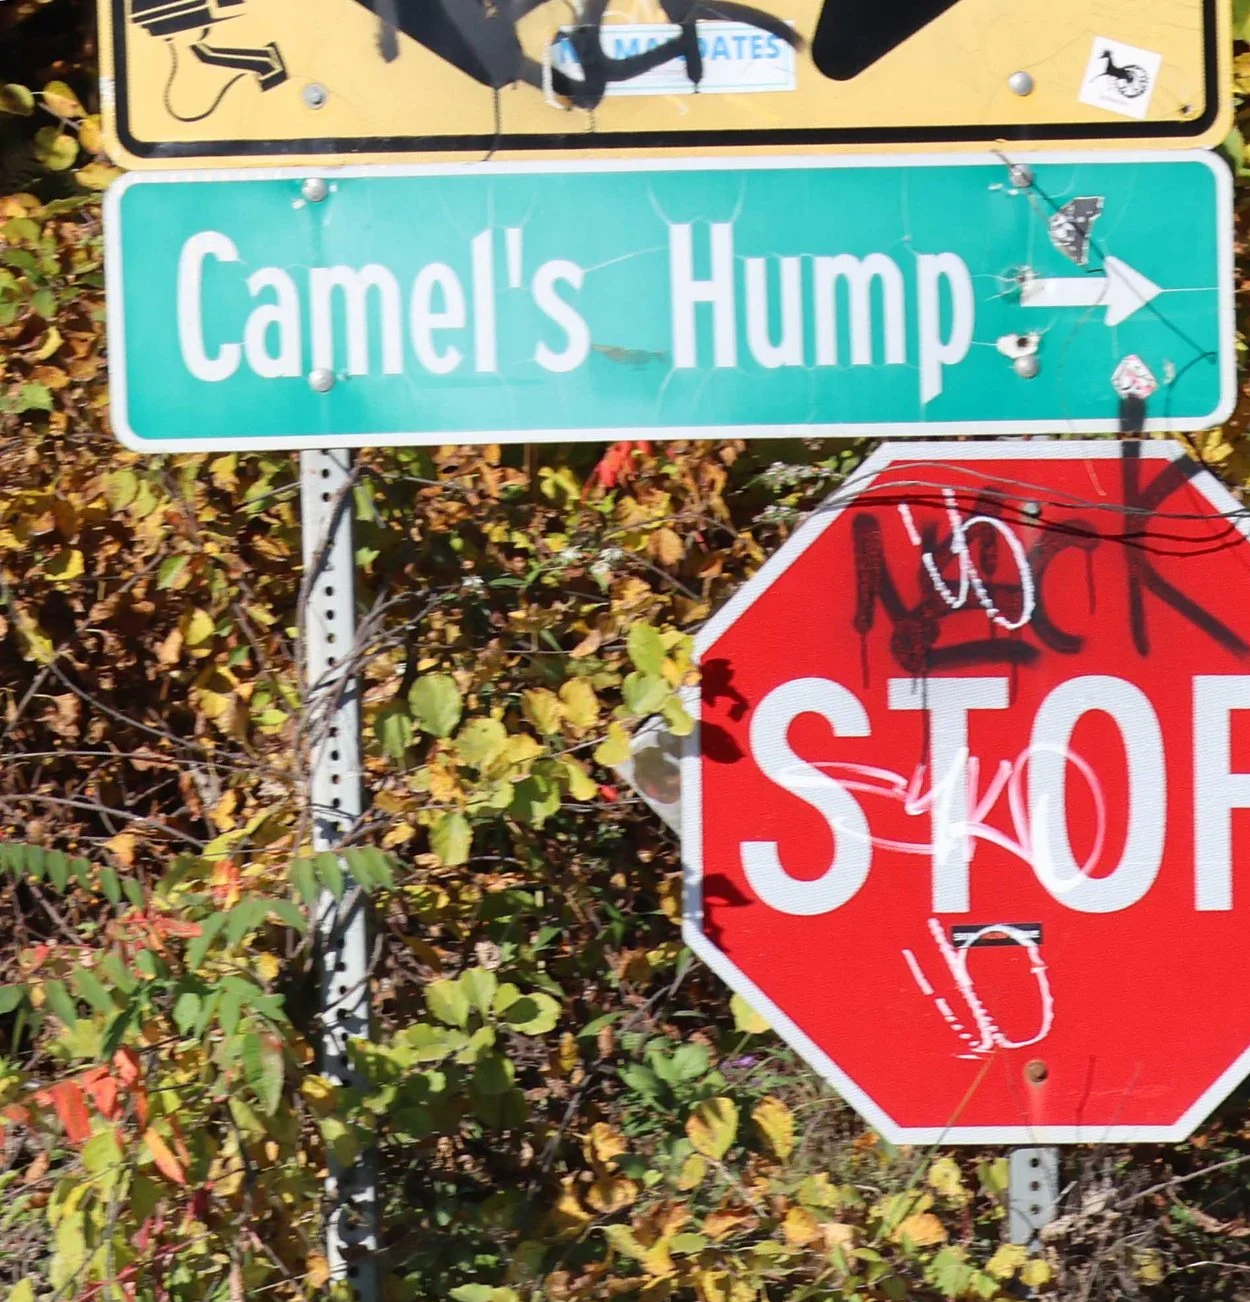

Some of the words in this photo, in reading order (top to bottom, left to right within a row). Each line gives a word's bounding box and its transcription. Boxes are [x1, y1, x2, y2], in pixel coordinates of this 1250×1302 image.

[613, 34, 782, 62] MDATES
[177, 228, 592, 382] Camel's
[668, 222, 976, 404] Hump
